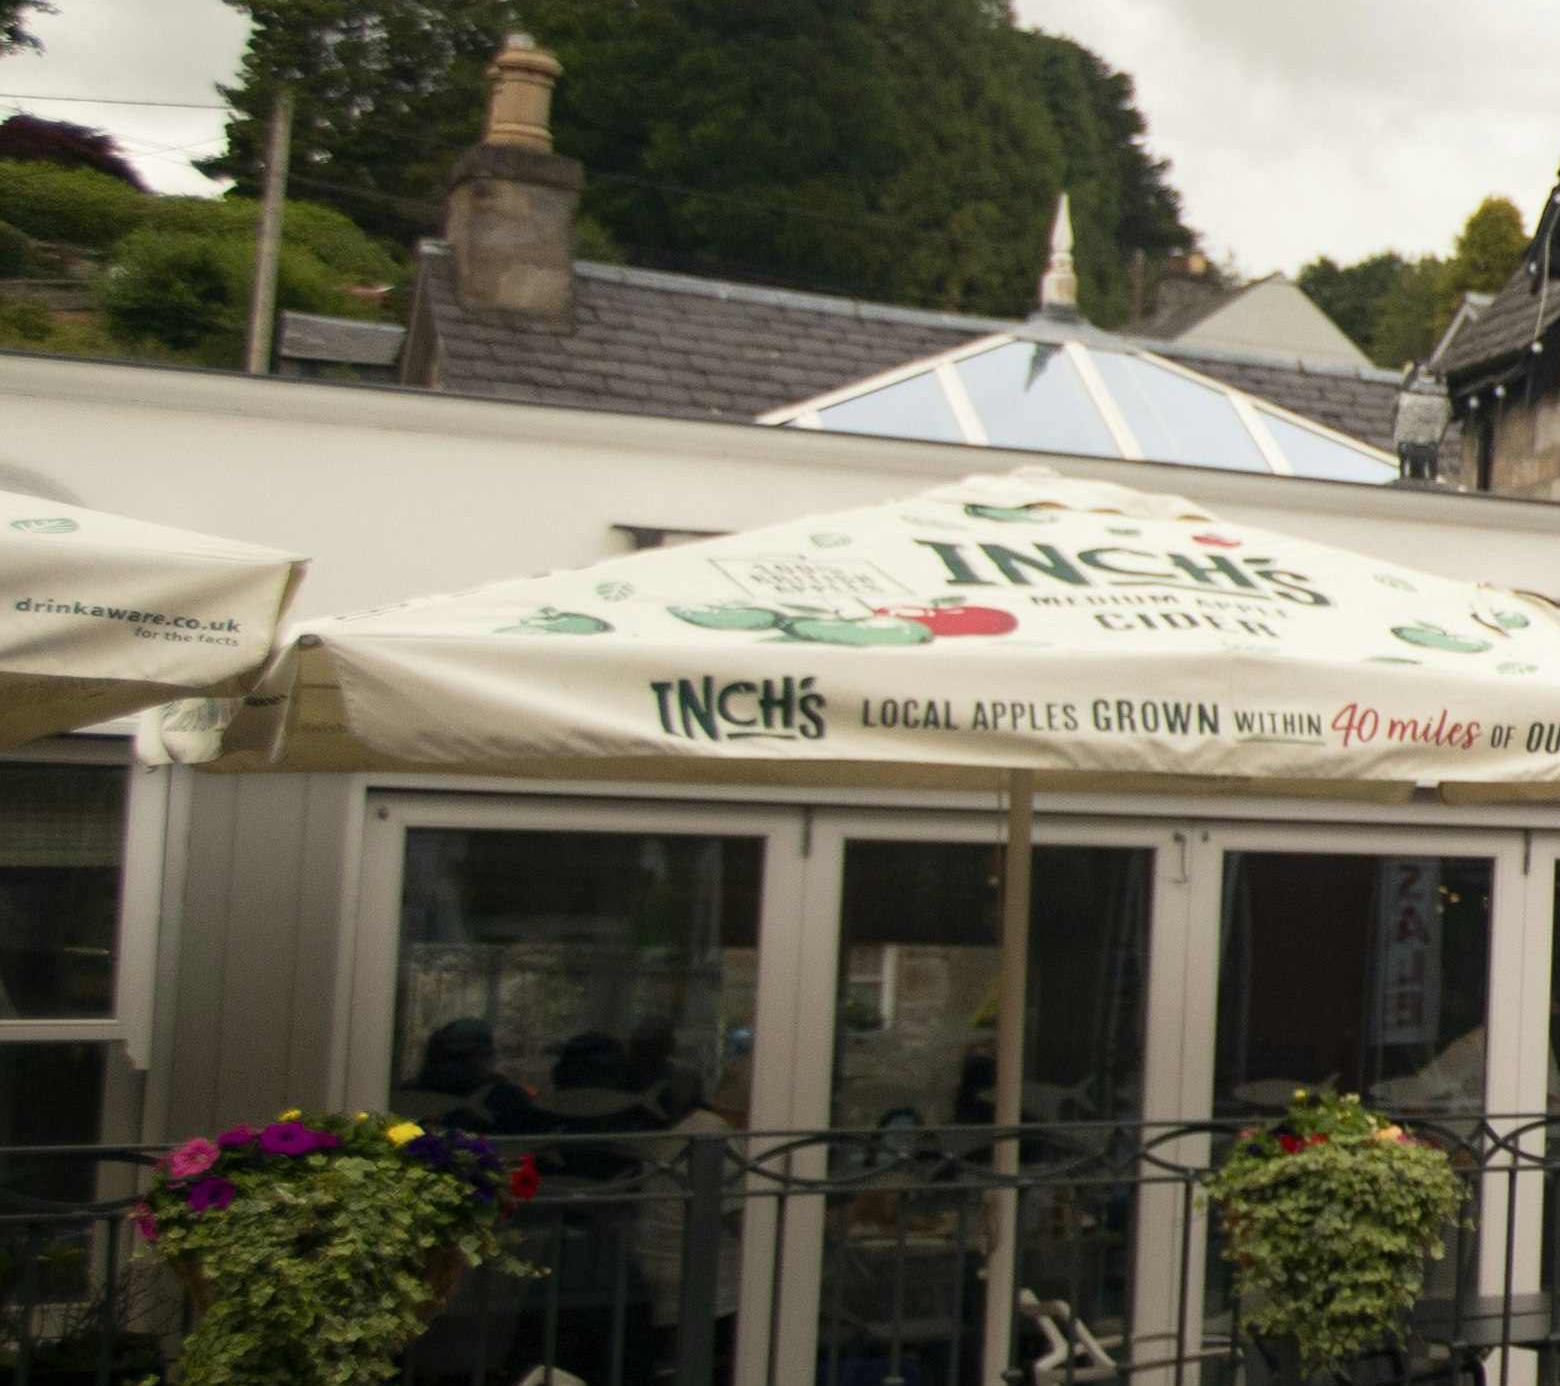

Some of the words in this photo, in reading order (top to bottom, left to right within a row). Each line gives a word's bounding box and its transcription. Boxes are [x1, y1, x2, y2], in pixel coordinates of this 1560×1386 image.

[15, 597, 242, 633] drinkaware.co.uk
[1093, 612, 1281, 639] CIDER
[133, 627, 161, 639] for
[164, 631, 193, 643] the
[198, 634, 241, 647] facts
[862, 697, 959, 731] LOCAL
[971, 701, 1079, 733] APPLES
[1092, 699, 1220, 735] GROWN
[1234, 710, 1322, 737] WITHIN
[1331, 702, 1379, 747] 40
[1387, 707, 1483, 751] miles
[1491, 724, 1514, 747] OF
